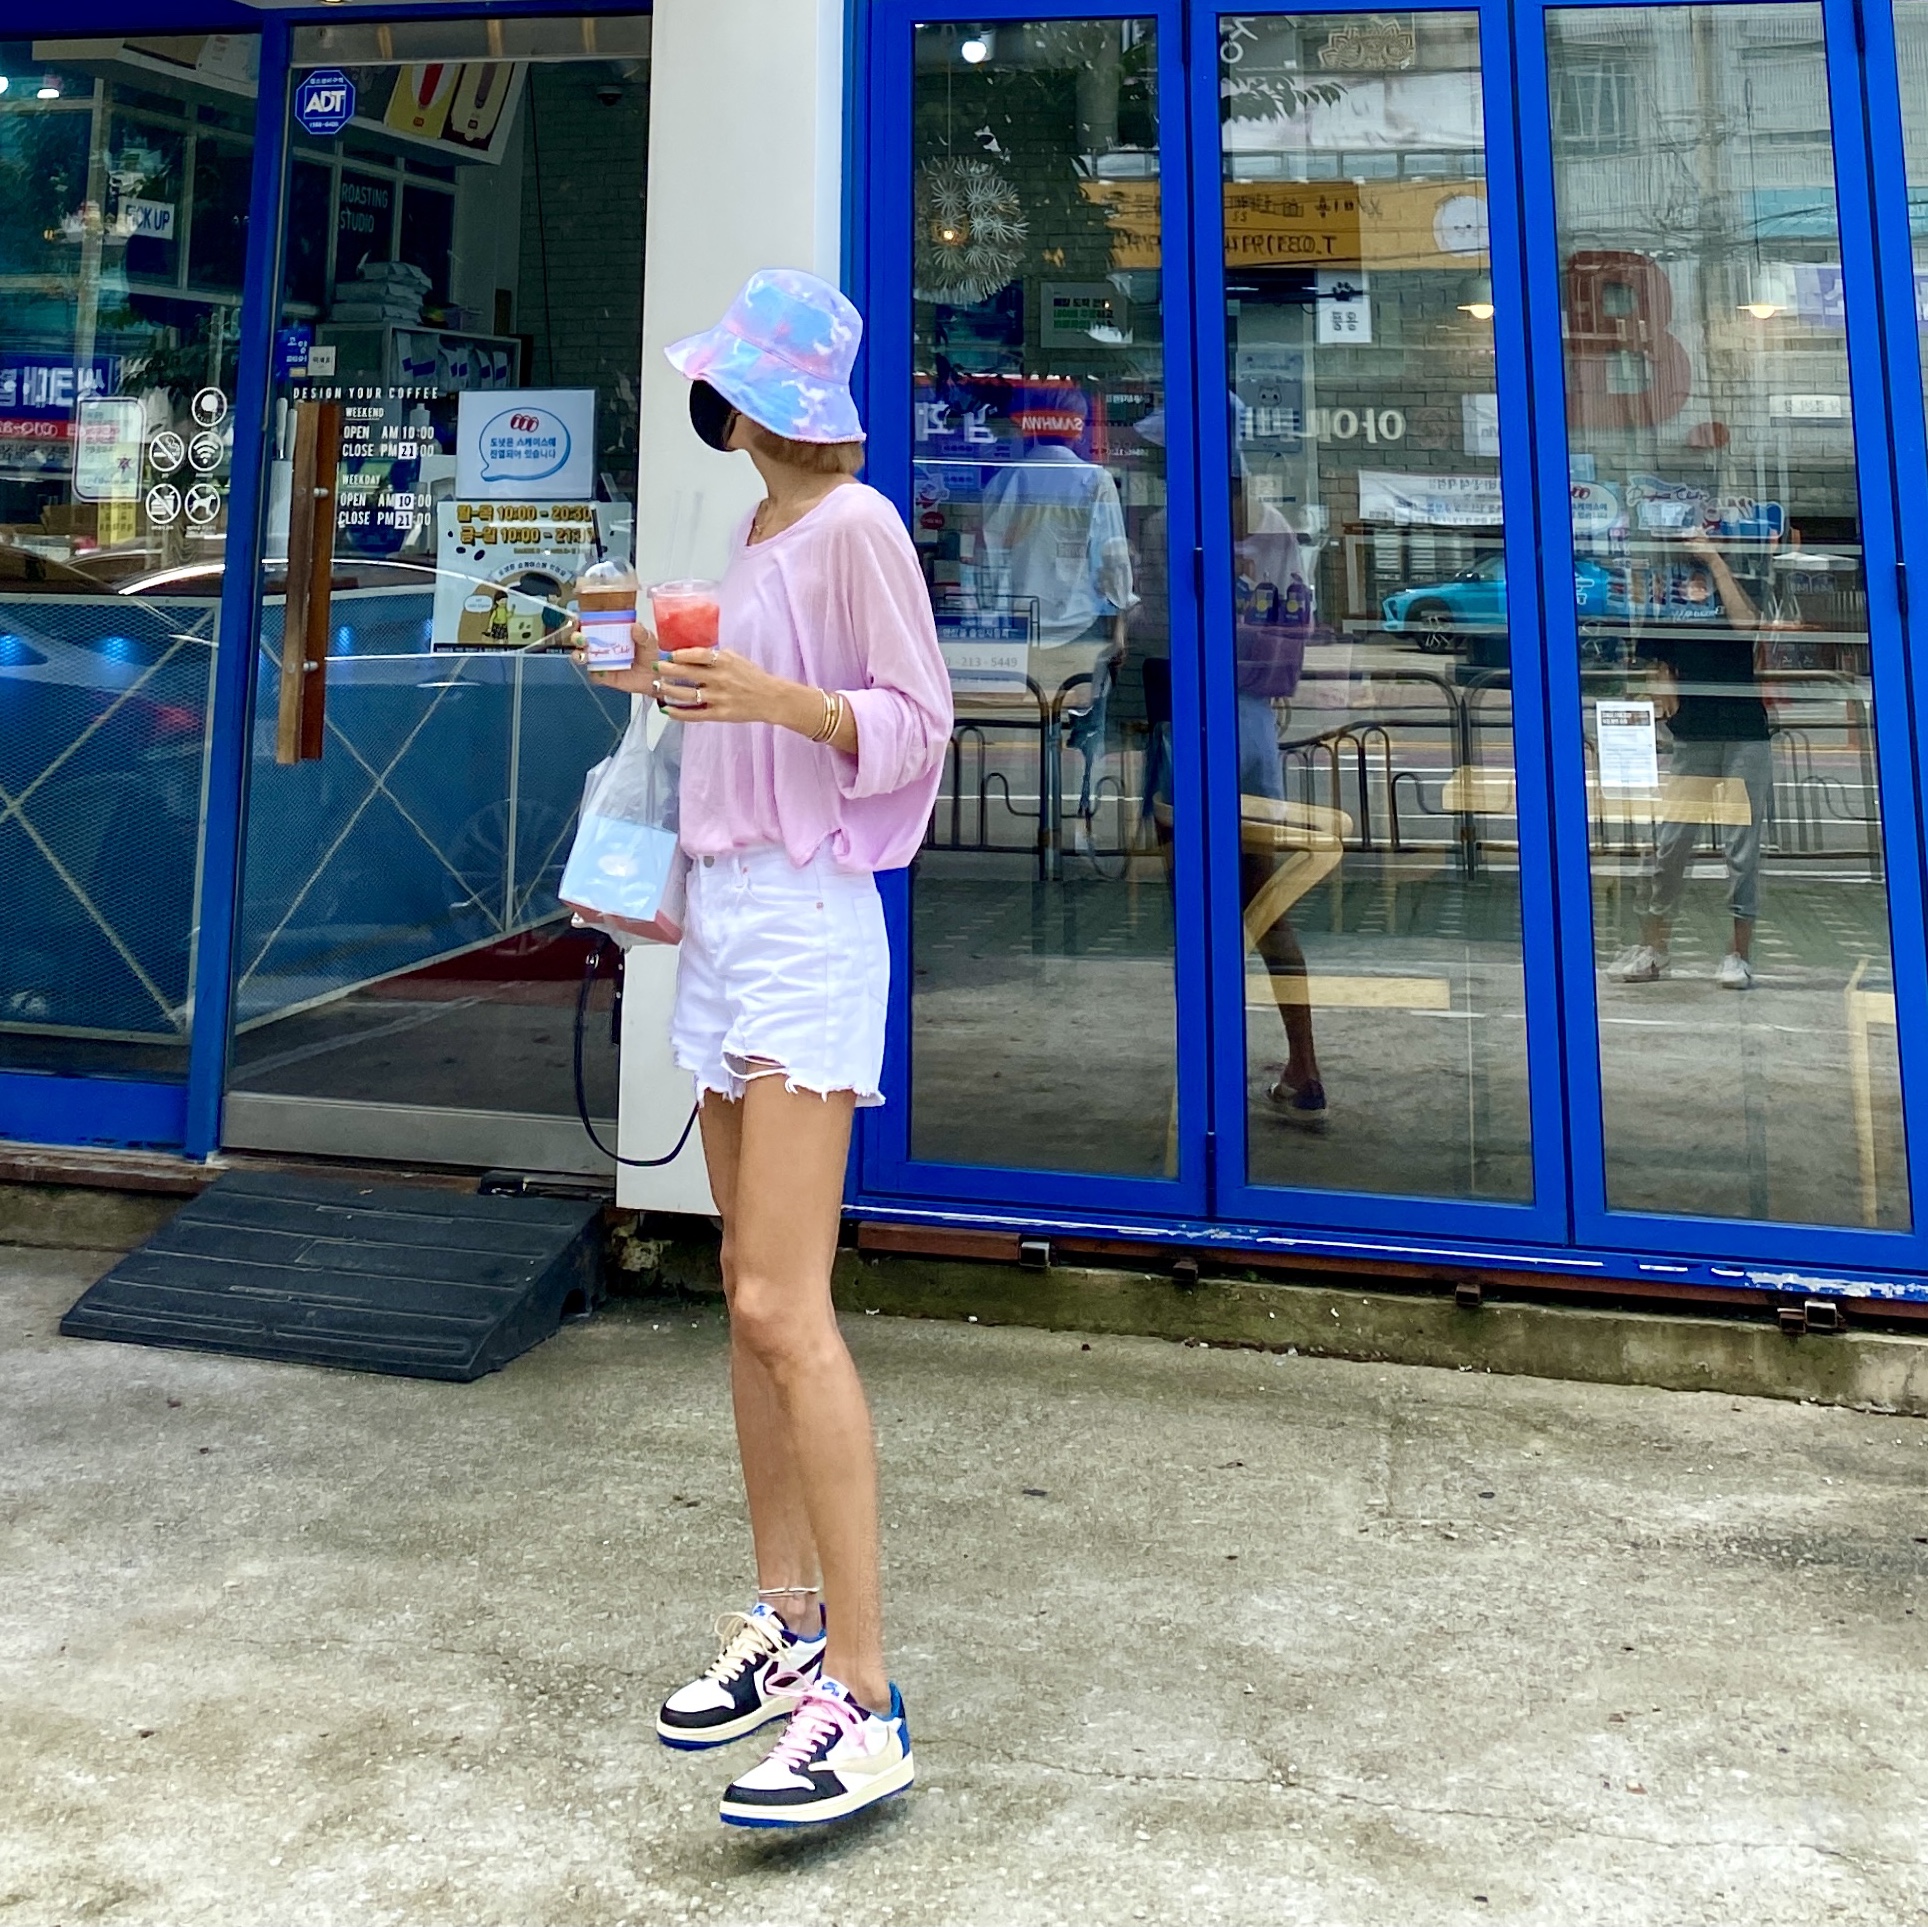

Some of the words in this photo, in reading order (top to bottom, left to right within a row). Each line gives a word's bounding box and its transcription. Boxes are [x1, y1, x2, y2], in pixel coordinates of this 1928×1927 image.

[304, 90, 346, 113] ADT
[341, 182, 389, 208] ROASTING
[154, 209, 171, 231] UP
[340, 207, 375, 233] STUDIO
[293, 387, 342, 399] DESIGN
[349, 387, 382, 399] YOUR
[389, 386, 438, 399] COFFEE
[345, 407, 384, 418] WEEKEND
[343, 426, 370, 440] OPEN
[381, 426, 399, 440] AM
[402, 426, 435, 440] 10:00
[490, 437, 514, 447] 도넛은
[342, 444, 375, 457] CLOSE
[380, 443, 398, 457] PM
[490, 449, 522, 459] 진열되어
[524, 449, 557, 459] 있습니다
[342, 474, 381, 485] WEEKDAY
[340, 493, 367, 507] OPEN
[378, 493, 396, 507] AM
[338, 511, 371, 526] CLOSE
[377, 511, 394, 526] PM
[498, 505, 537, 522] 10:00
[552, 505, 593, 522] 20:30
[501, 527, 541, 544] 10:00
